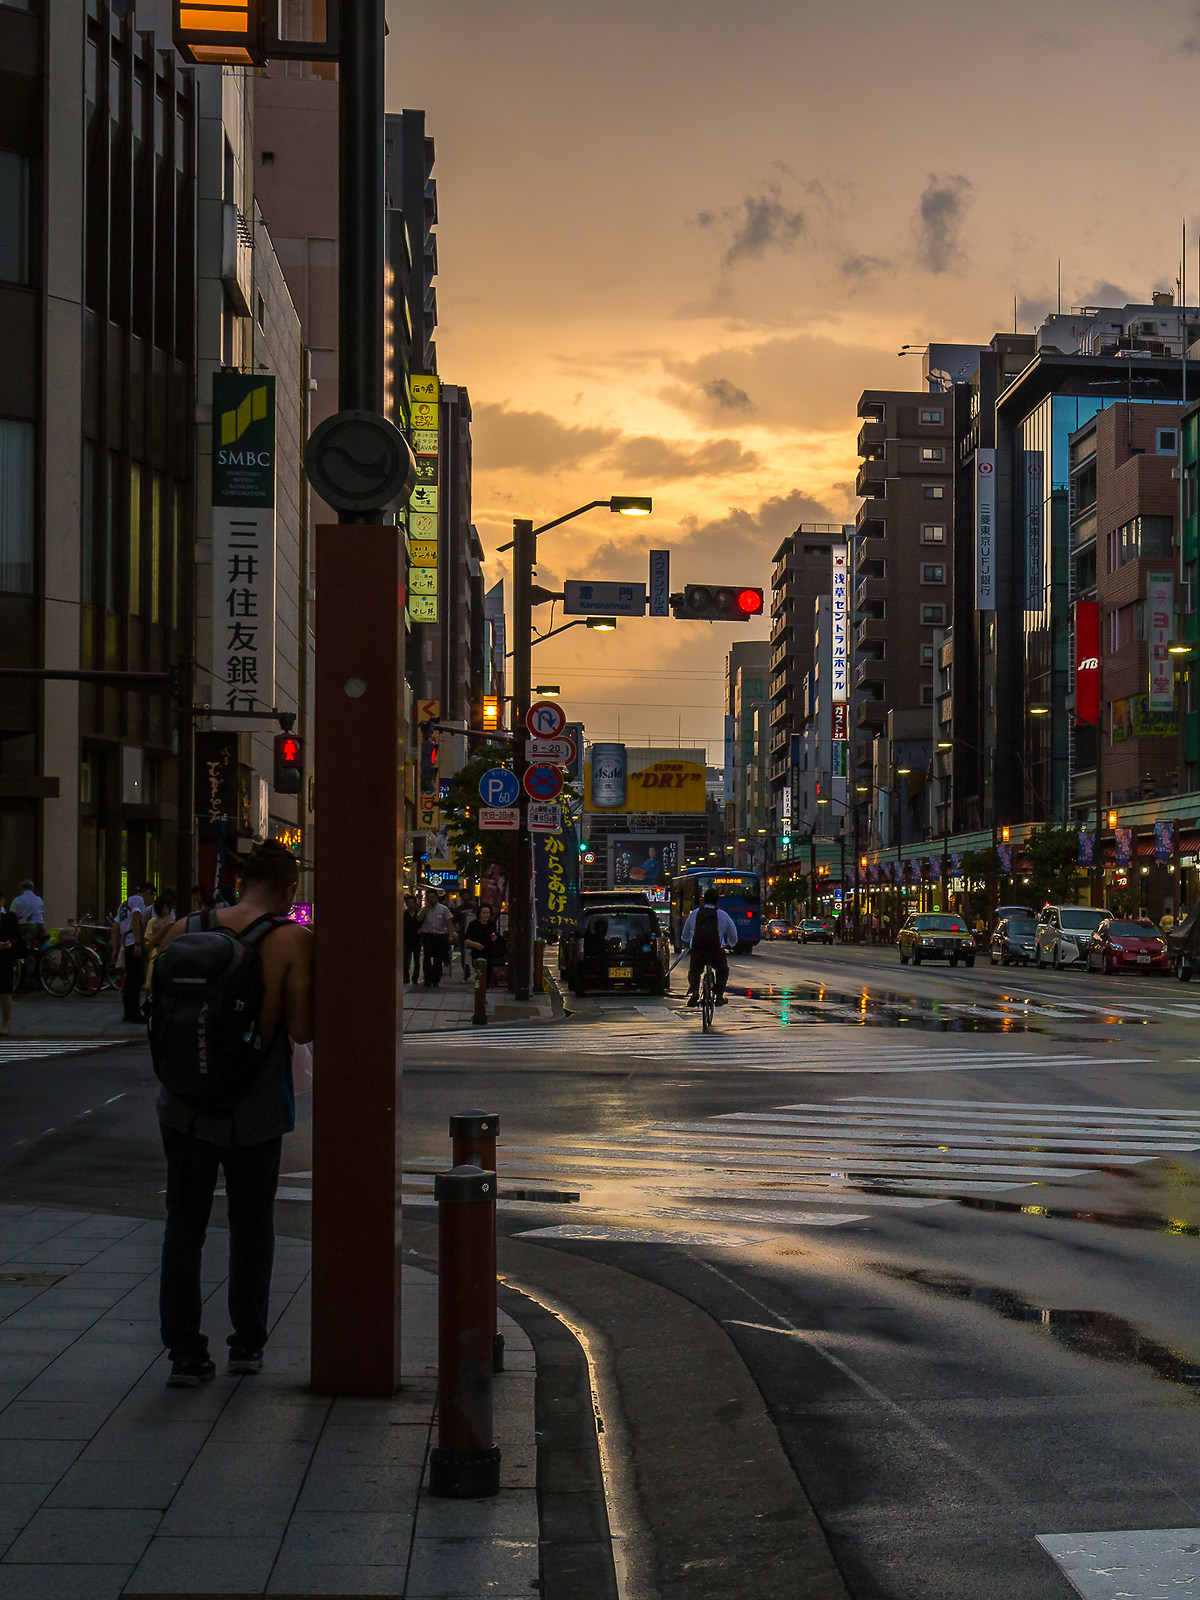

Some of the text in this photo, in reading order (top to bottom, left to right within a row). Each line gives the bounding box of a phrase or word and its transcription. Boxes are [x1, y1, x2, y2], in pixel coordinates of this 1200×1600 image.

[218, 450, 270, 467] SMBC
[980, 503, 991, 596] 三菱東京UFJ銀行
[579, 586, 633, 601] 雷門
[580, 601, 632, 610] Kaminarimon
[226, 520, 259, 712] 三井住友銀行
[834, 573, 846, 691] 浅草セントラルホテル
[1078, 656, 1099, 671] JTB
[835, 705, 844, 733] ガスト
[595, 767, 623, 779] Asahi
[653, 763, 684, 772] SUPER
[488, 778, 504, 803] P
[498, 792, 510, 803] 60
